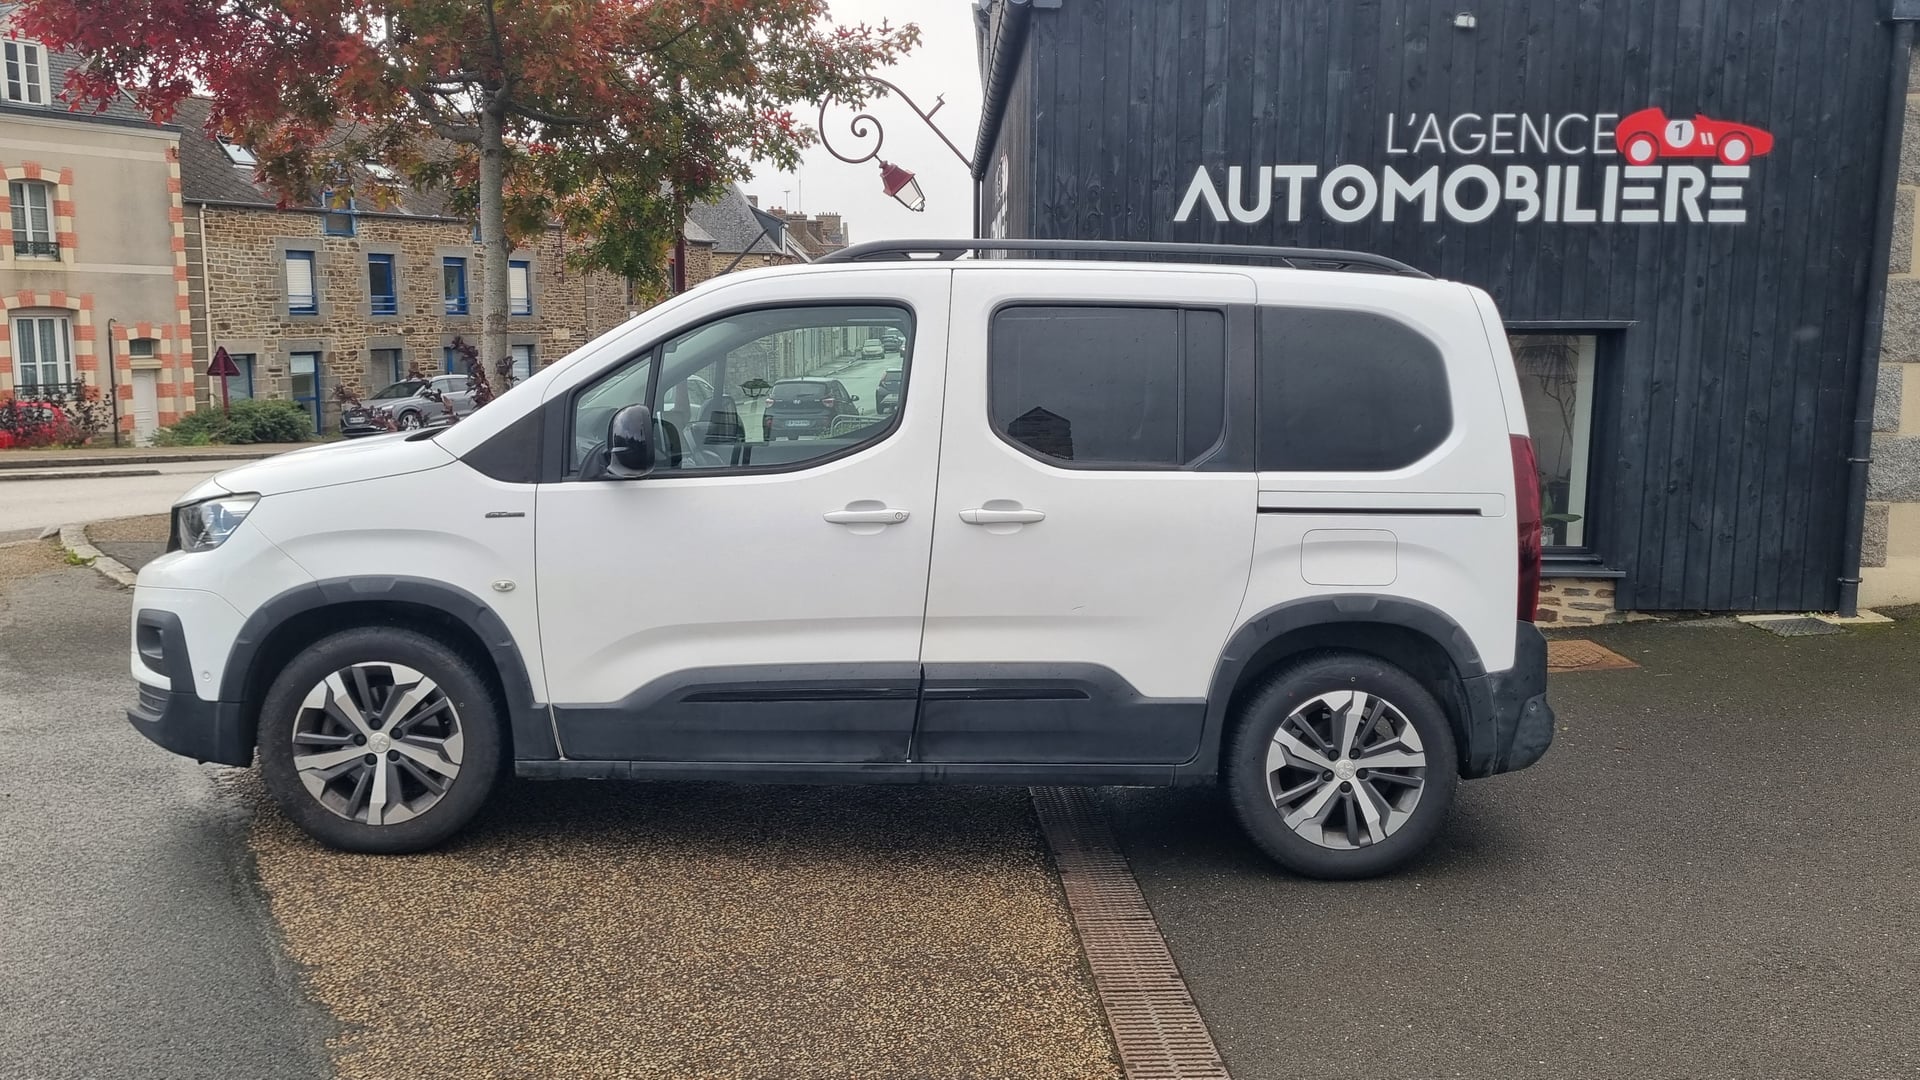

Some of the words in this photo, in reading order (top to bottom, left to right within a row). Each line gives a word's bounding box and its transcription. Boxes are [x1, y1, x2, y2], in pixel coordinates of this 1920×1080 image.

[1387, 112, 1619, 154] L'AGENCE
[1674, 122, 1684, 141] 1
[1173, 164, 1750, 223] AUTOMOBILIERE
